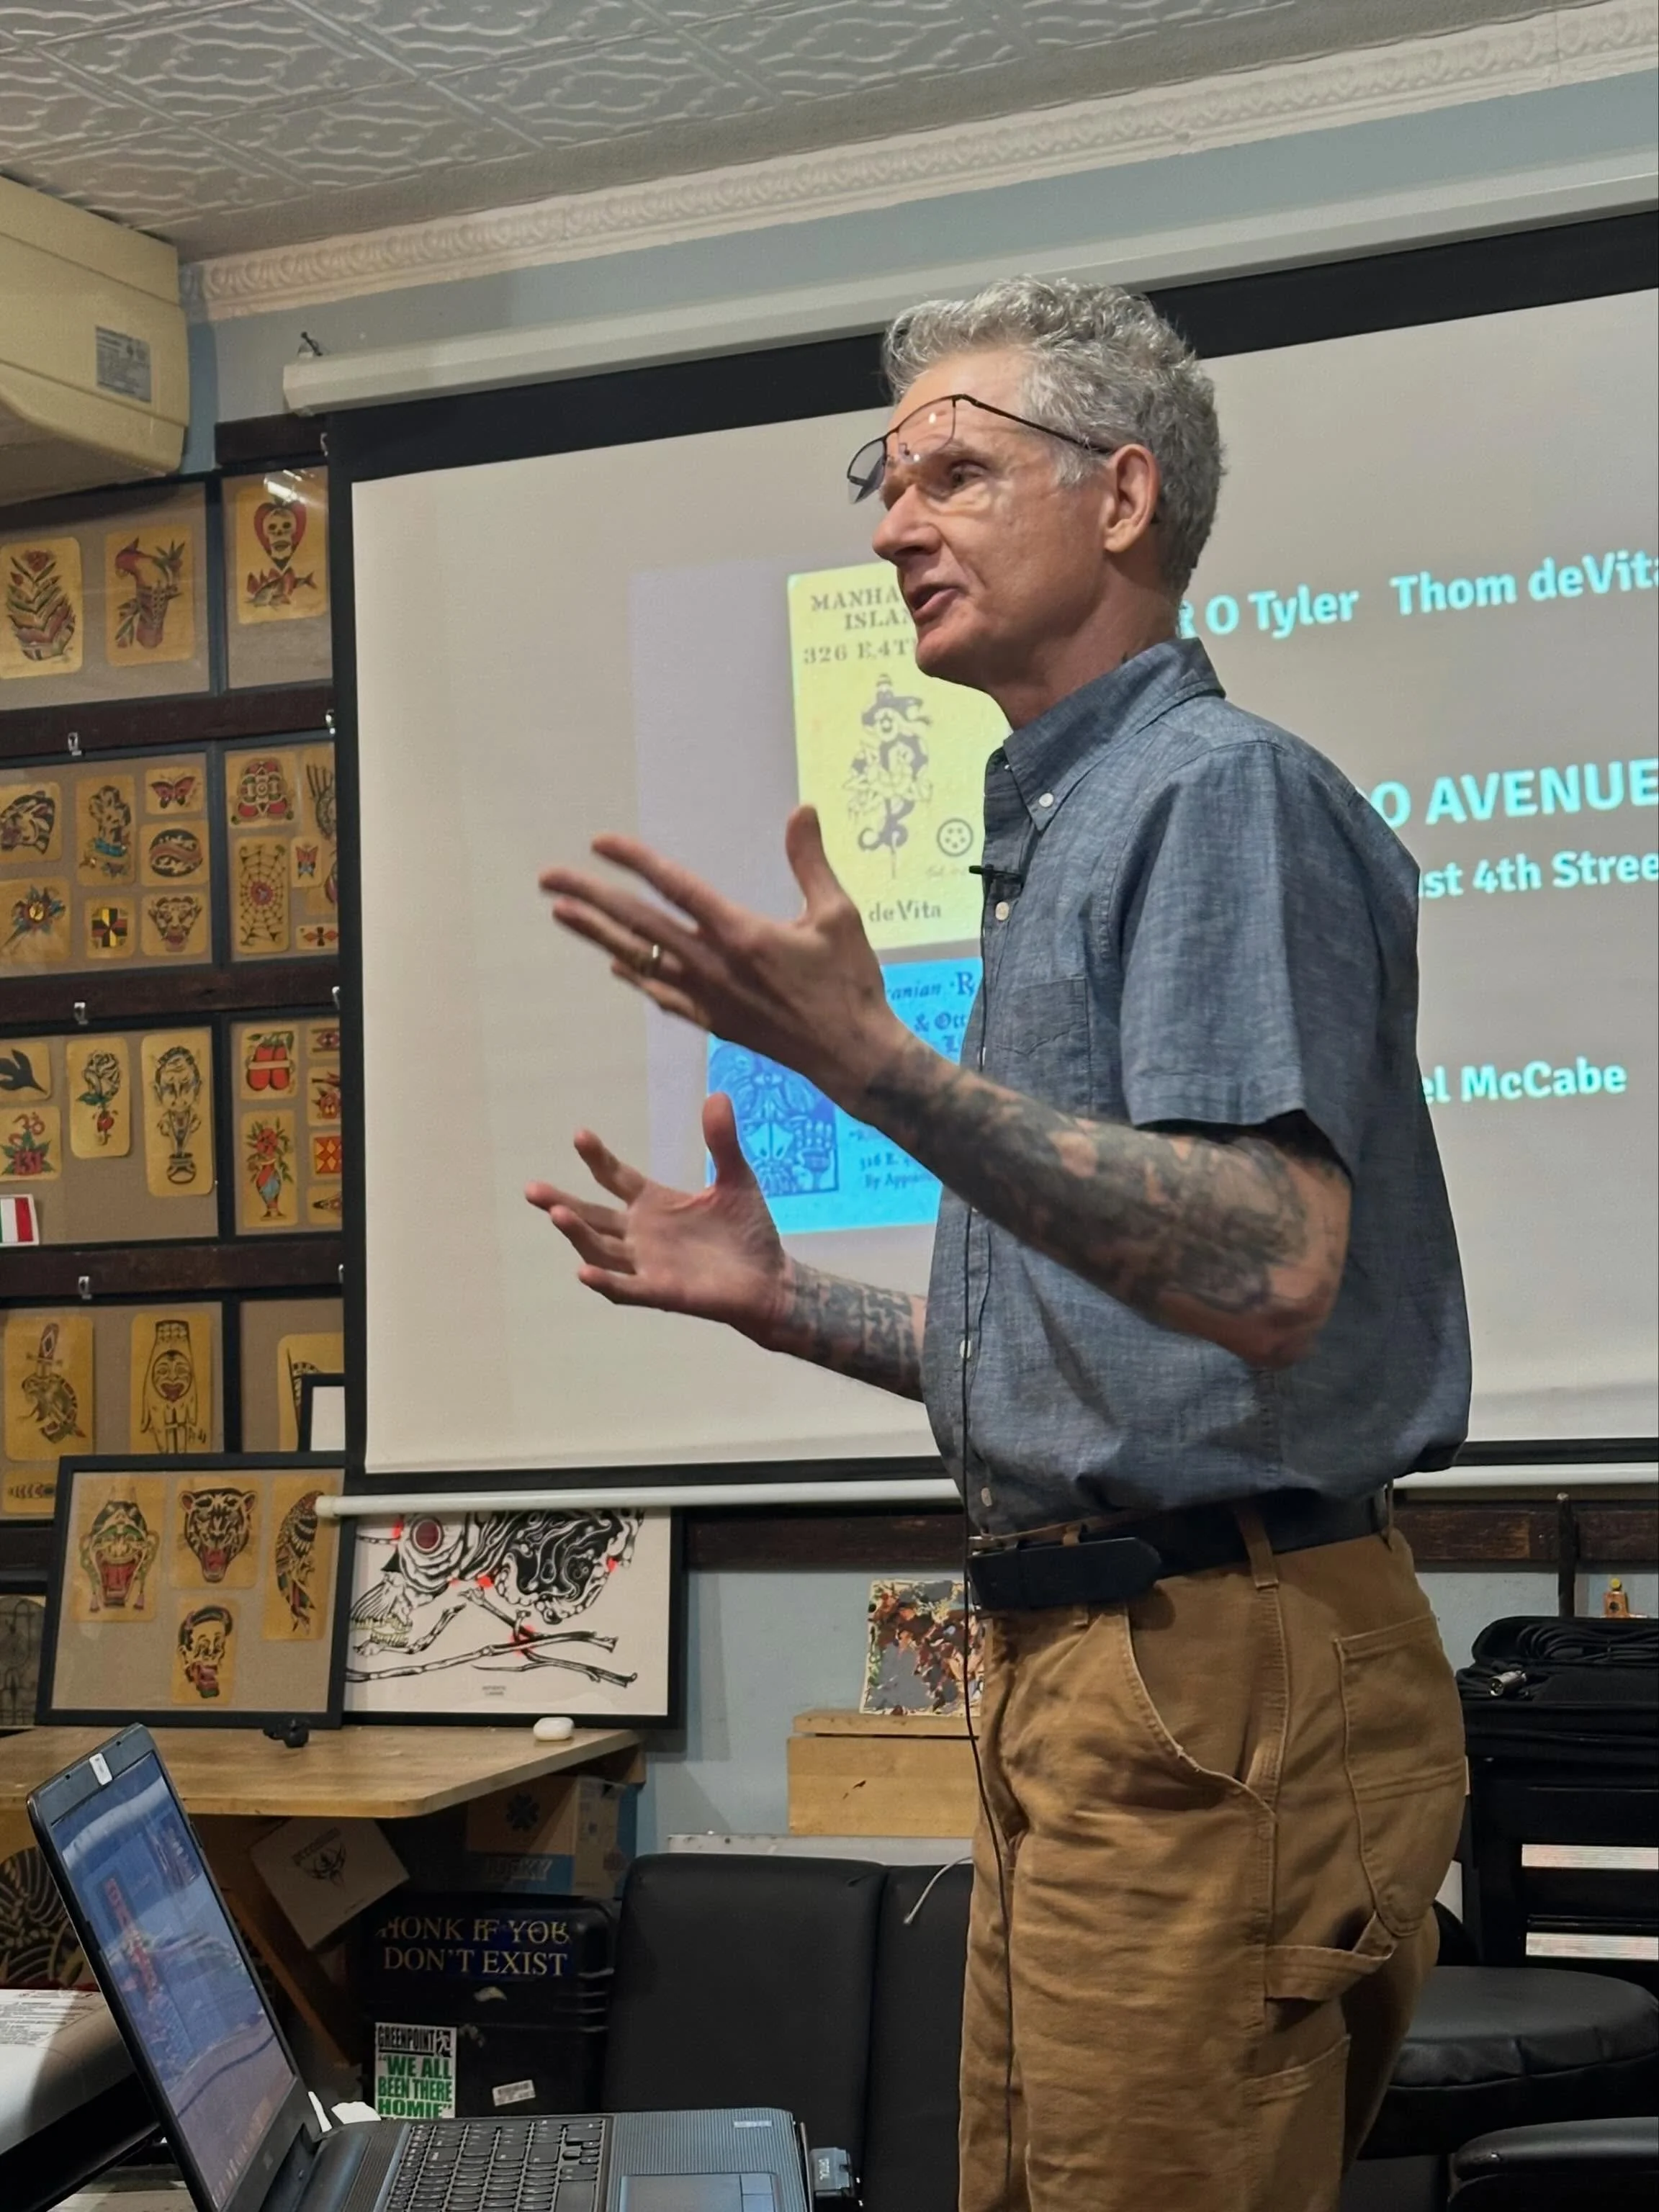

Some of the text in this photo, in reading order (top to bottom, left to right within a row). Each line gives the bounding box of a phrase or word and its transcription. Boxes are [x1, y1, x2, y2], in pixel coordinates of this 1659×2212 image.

[1205, 594, 1239, 635] O
[1247, 585, 1360, 638] Tyler
[1390, 572, 1517, 616] Thom
[1528, 549, 1658, 602] deVit
[1425, 758, 1658, 825] AVENUE
[1419, 862, 1464, 899] st
[1473, 854, 1542, 894] 4th
[868, 899, 942, 922] deVita
[1460, 1056, 1627, 1102] McCabe
[472, 1918, 500, 1942] IF
[507, 1920, 573, 1945] YOU
[383, 1946, 568, 1977] DON'T EXIST
[378, 2025, 435, 2052] GREENPOINT
[421, 2056, 452, 2080] ALL
[378, 2076, 452, 2102] BEEN THERE
